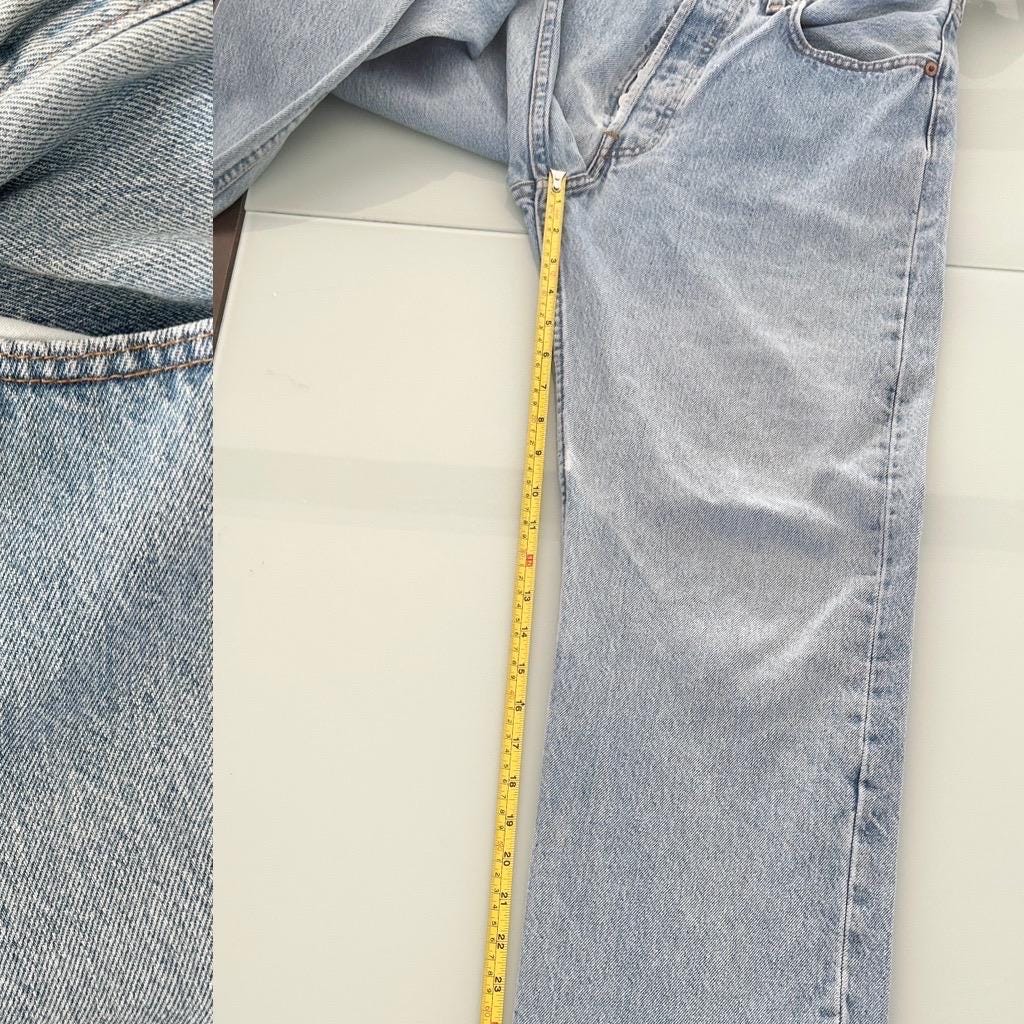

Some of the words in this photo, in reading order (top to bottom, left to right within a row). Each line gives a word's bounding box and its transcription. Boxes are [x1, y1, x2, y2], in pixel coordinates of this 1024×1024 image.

[532, 486, 539, 497] 10
[530, 520, 536, 530] 11
[524, 590, 531, 602] 13
[521, 626, 528, 638] 14
[516, 700, 522, 712] 16
[513, 738, 520, 750] 17
[509, 775, 517, 788] 18
[506, 814, 514, 827] 19
[504, 851, 511, 867] 20
[500, 892, 508, 906] 21
[497, 934, 505, 950] 22
[494, 976, 502, 992] 23
